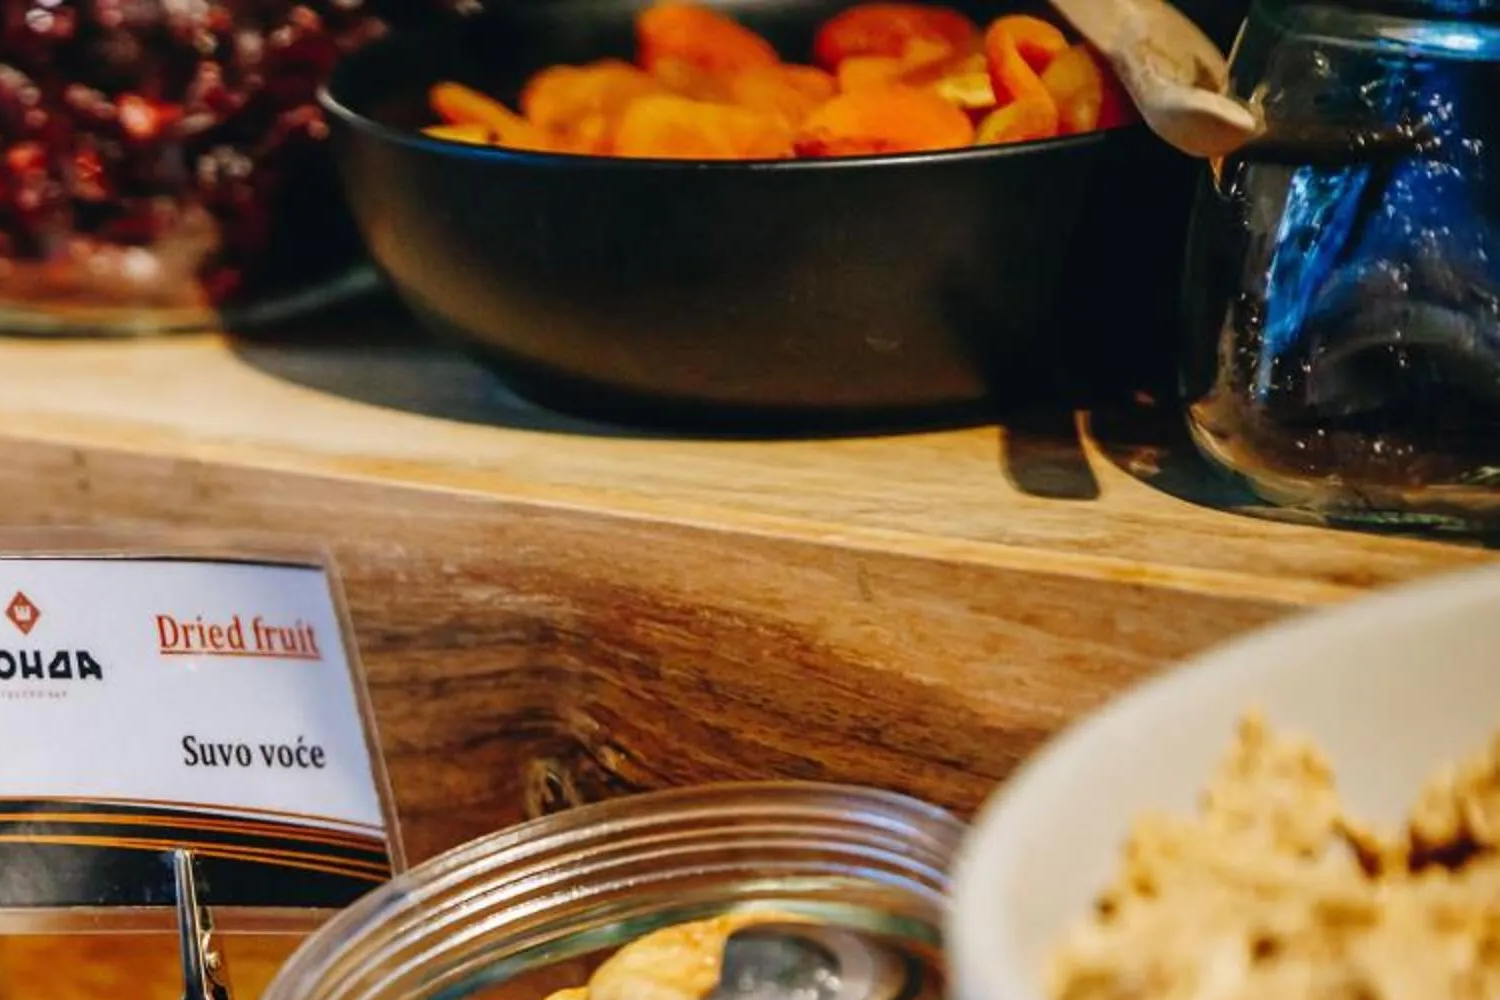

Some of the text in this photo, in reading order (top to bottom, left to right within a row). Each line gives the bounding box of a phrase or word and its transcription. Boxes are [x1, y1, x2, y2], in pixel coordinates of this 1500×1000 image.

[156, 613, 319, 654] Dried fruit
[182, 735, 326, 769] Suvo voće
